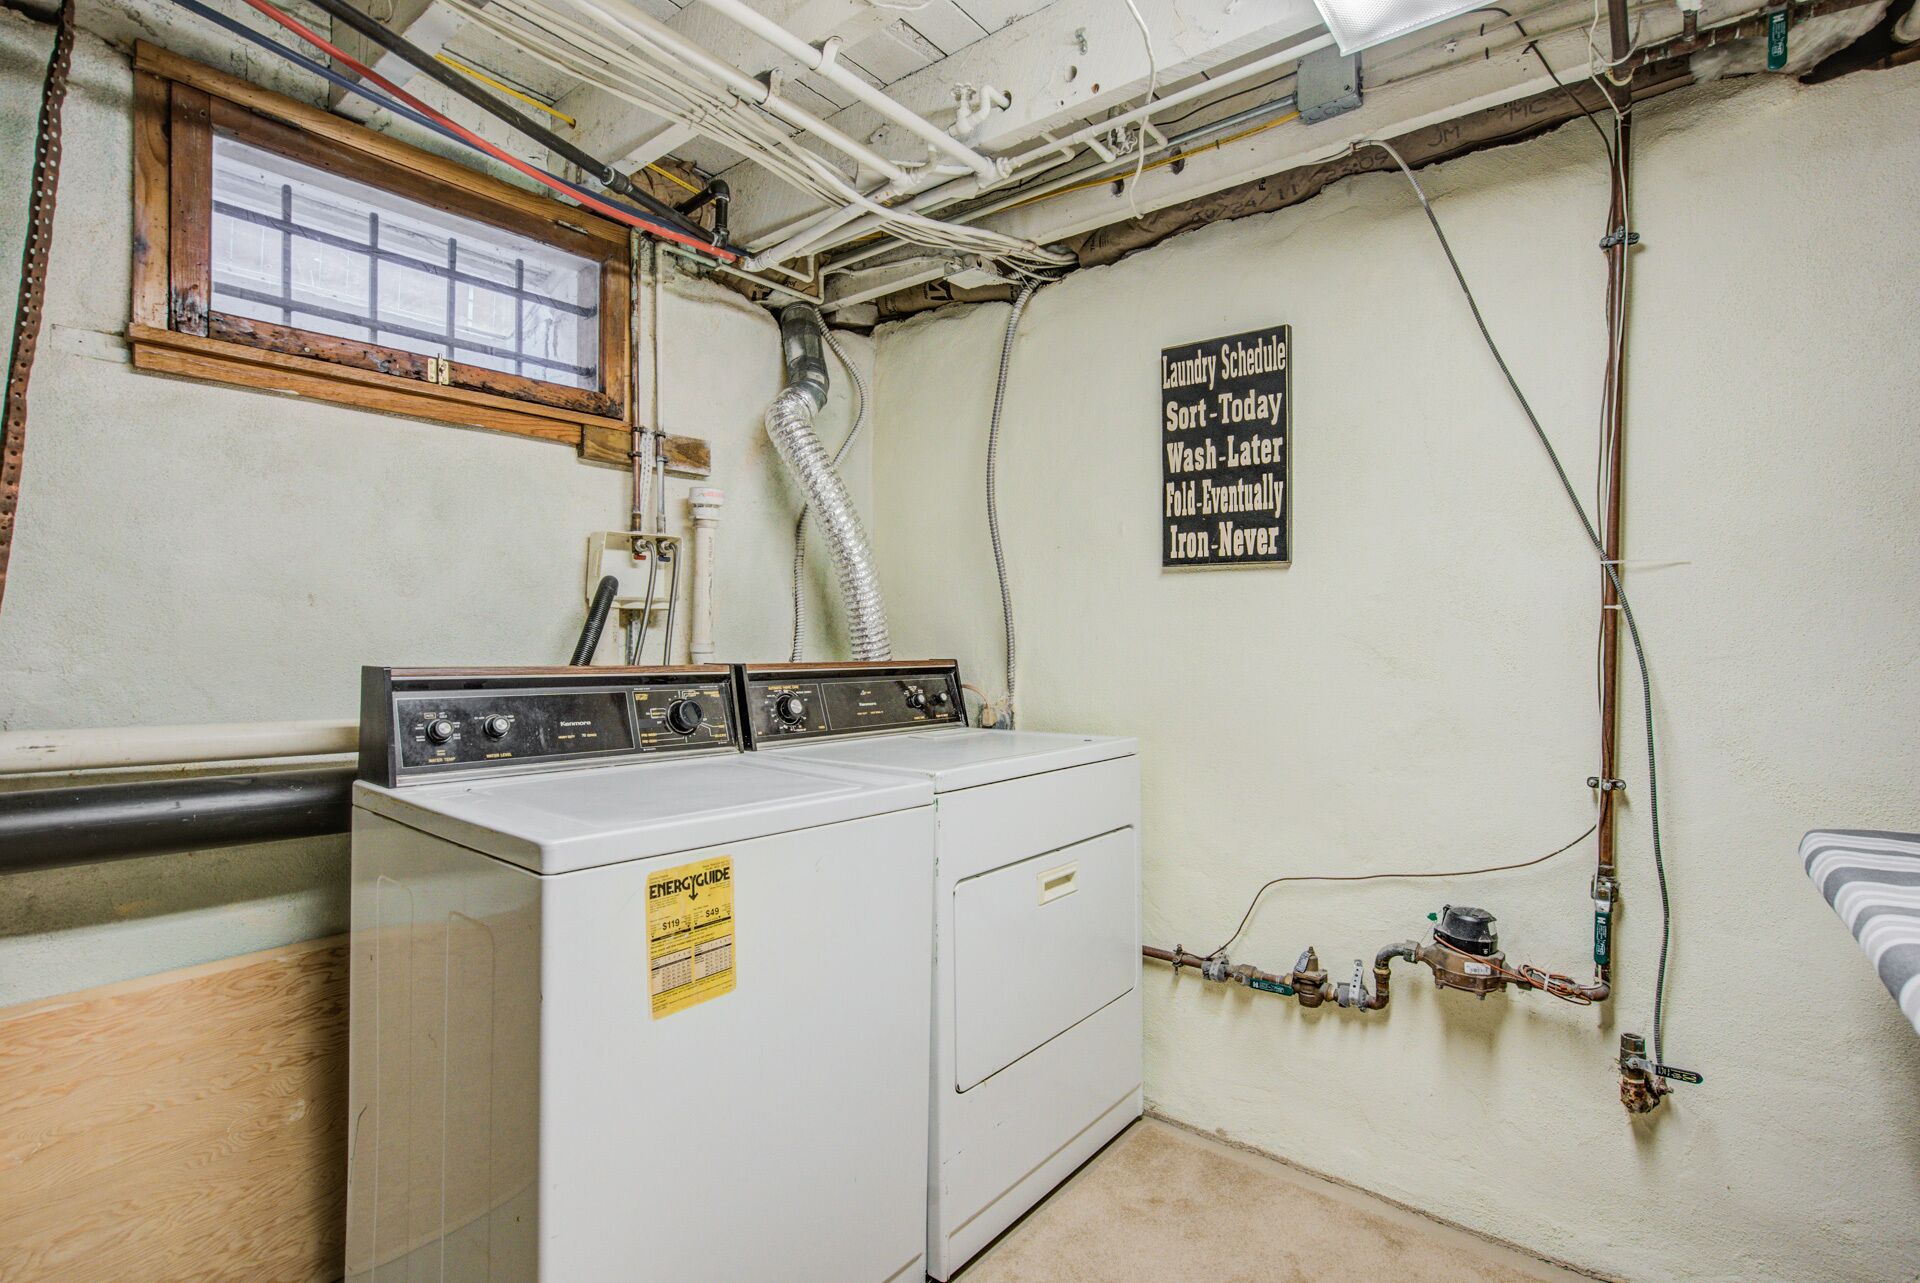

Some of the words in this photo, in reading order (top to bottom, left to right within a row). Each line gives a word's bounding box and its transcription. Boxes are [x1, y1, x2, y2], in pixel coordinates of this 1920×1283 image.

[1162, 349, 1217, 390] Laundry
[1221, 335, 1286, 380] Schedule
[649, 867, 731, 901] ENERGYGUIDE
[705, 907, 720, 918] $49
[662, 919, 680, 931] $119
